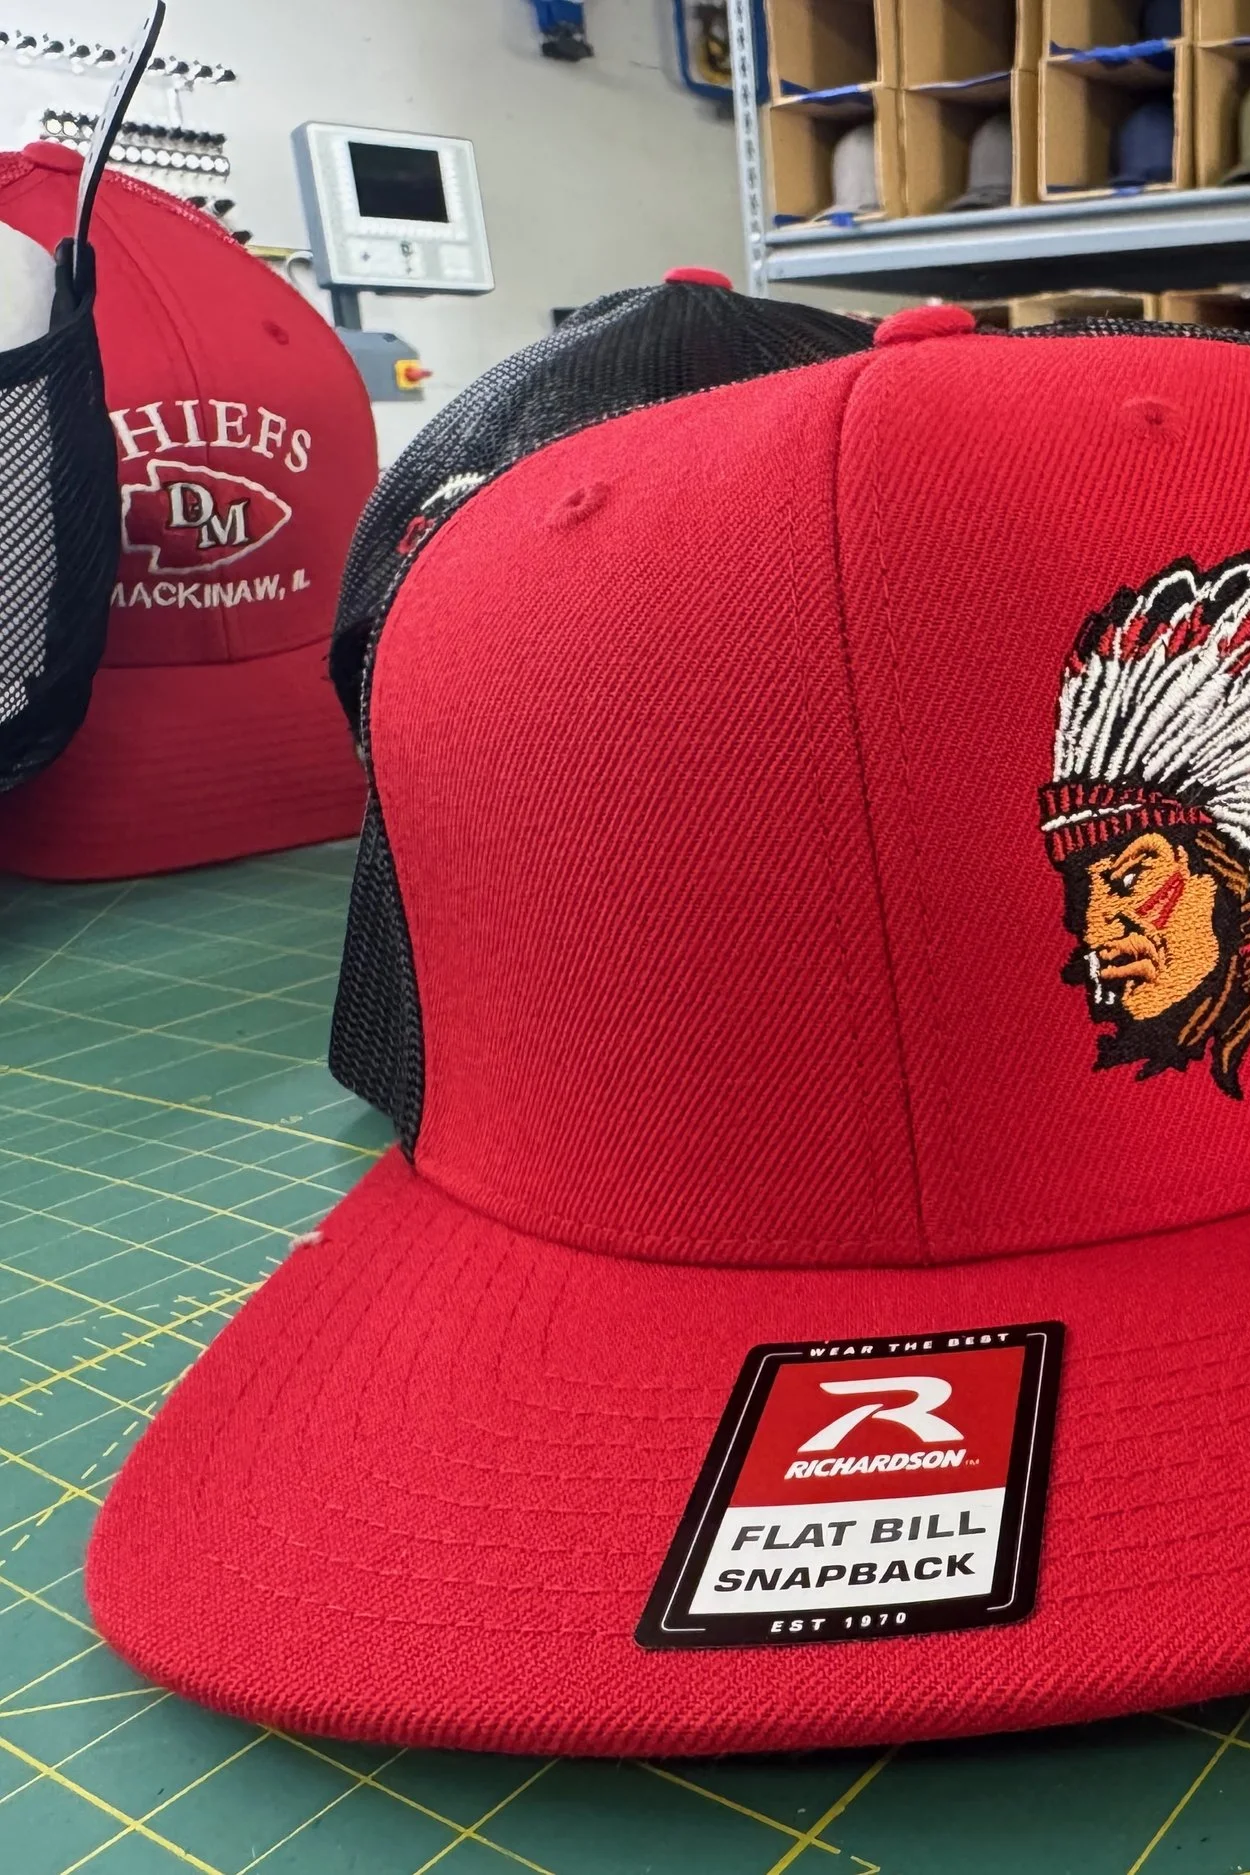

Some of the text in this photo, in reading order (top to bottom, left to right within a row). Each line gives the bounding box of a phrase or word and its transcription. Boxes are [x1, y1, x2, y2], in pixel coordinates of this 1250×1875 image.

[108, 399, 312, 473] HIEFS
[166, 481, 251, 550] DM
[292, 568, 311, 592] IL
[810, 1332, 1010, 1358] WEAR THE BEST
[783, 1448, 967, 1480] RICHARDSON
[731, 1509, 987, 1552] FLAT BILL
[713, 1552, 976, 1592] SNAPBACK
[770, 1611, 907, 1633] EST 1970
